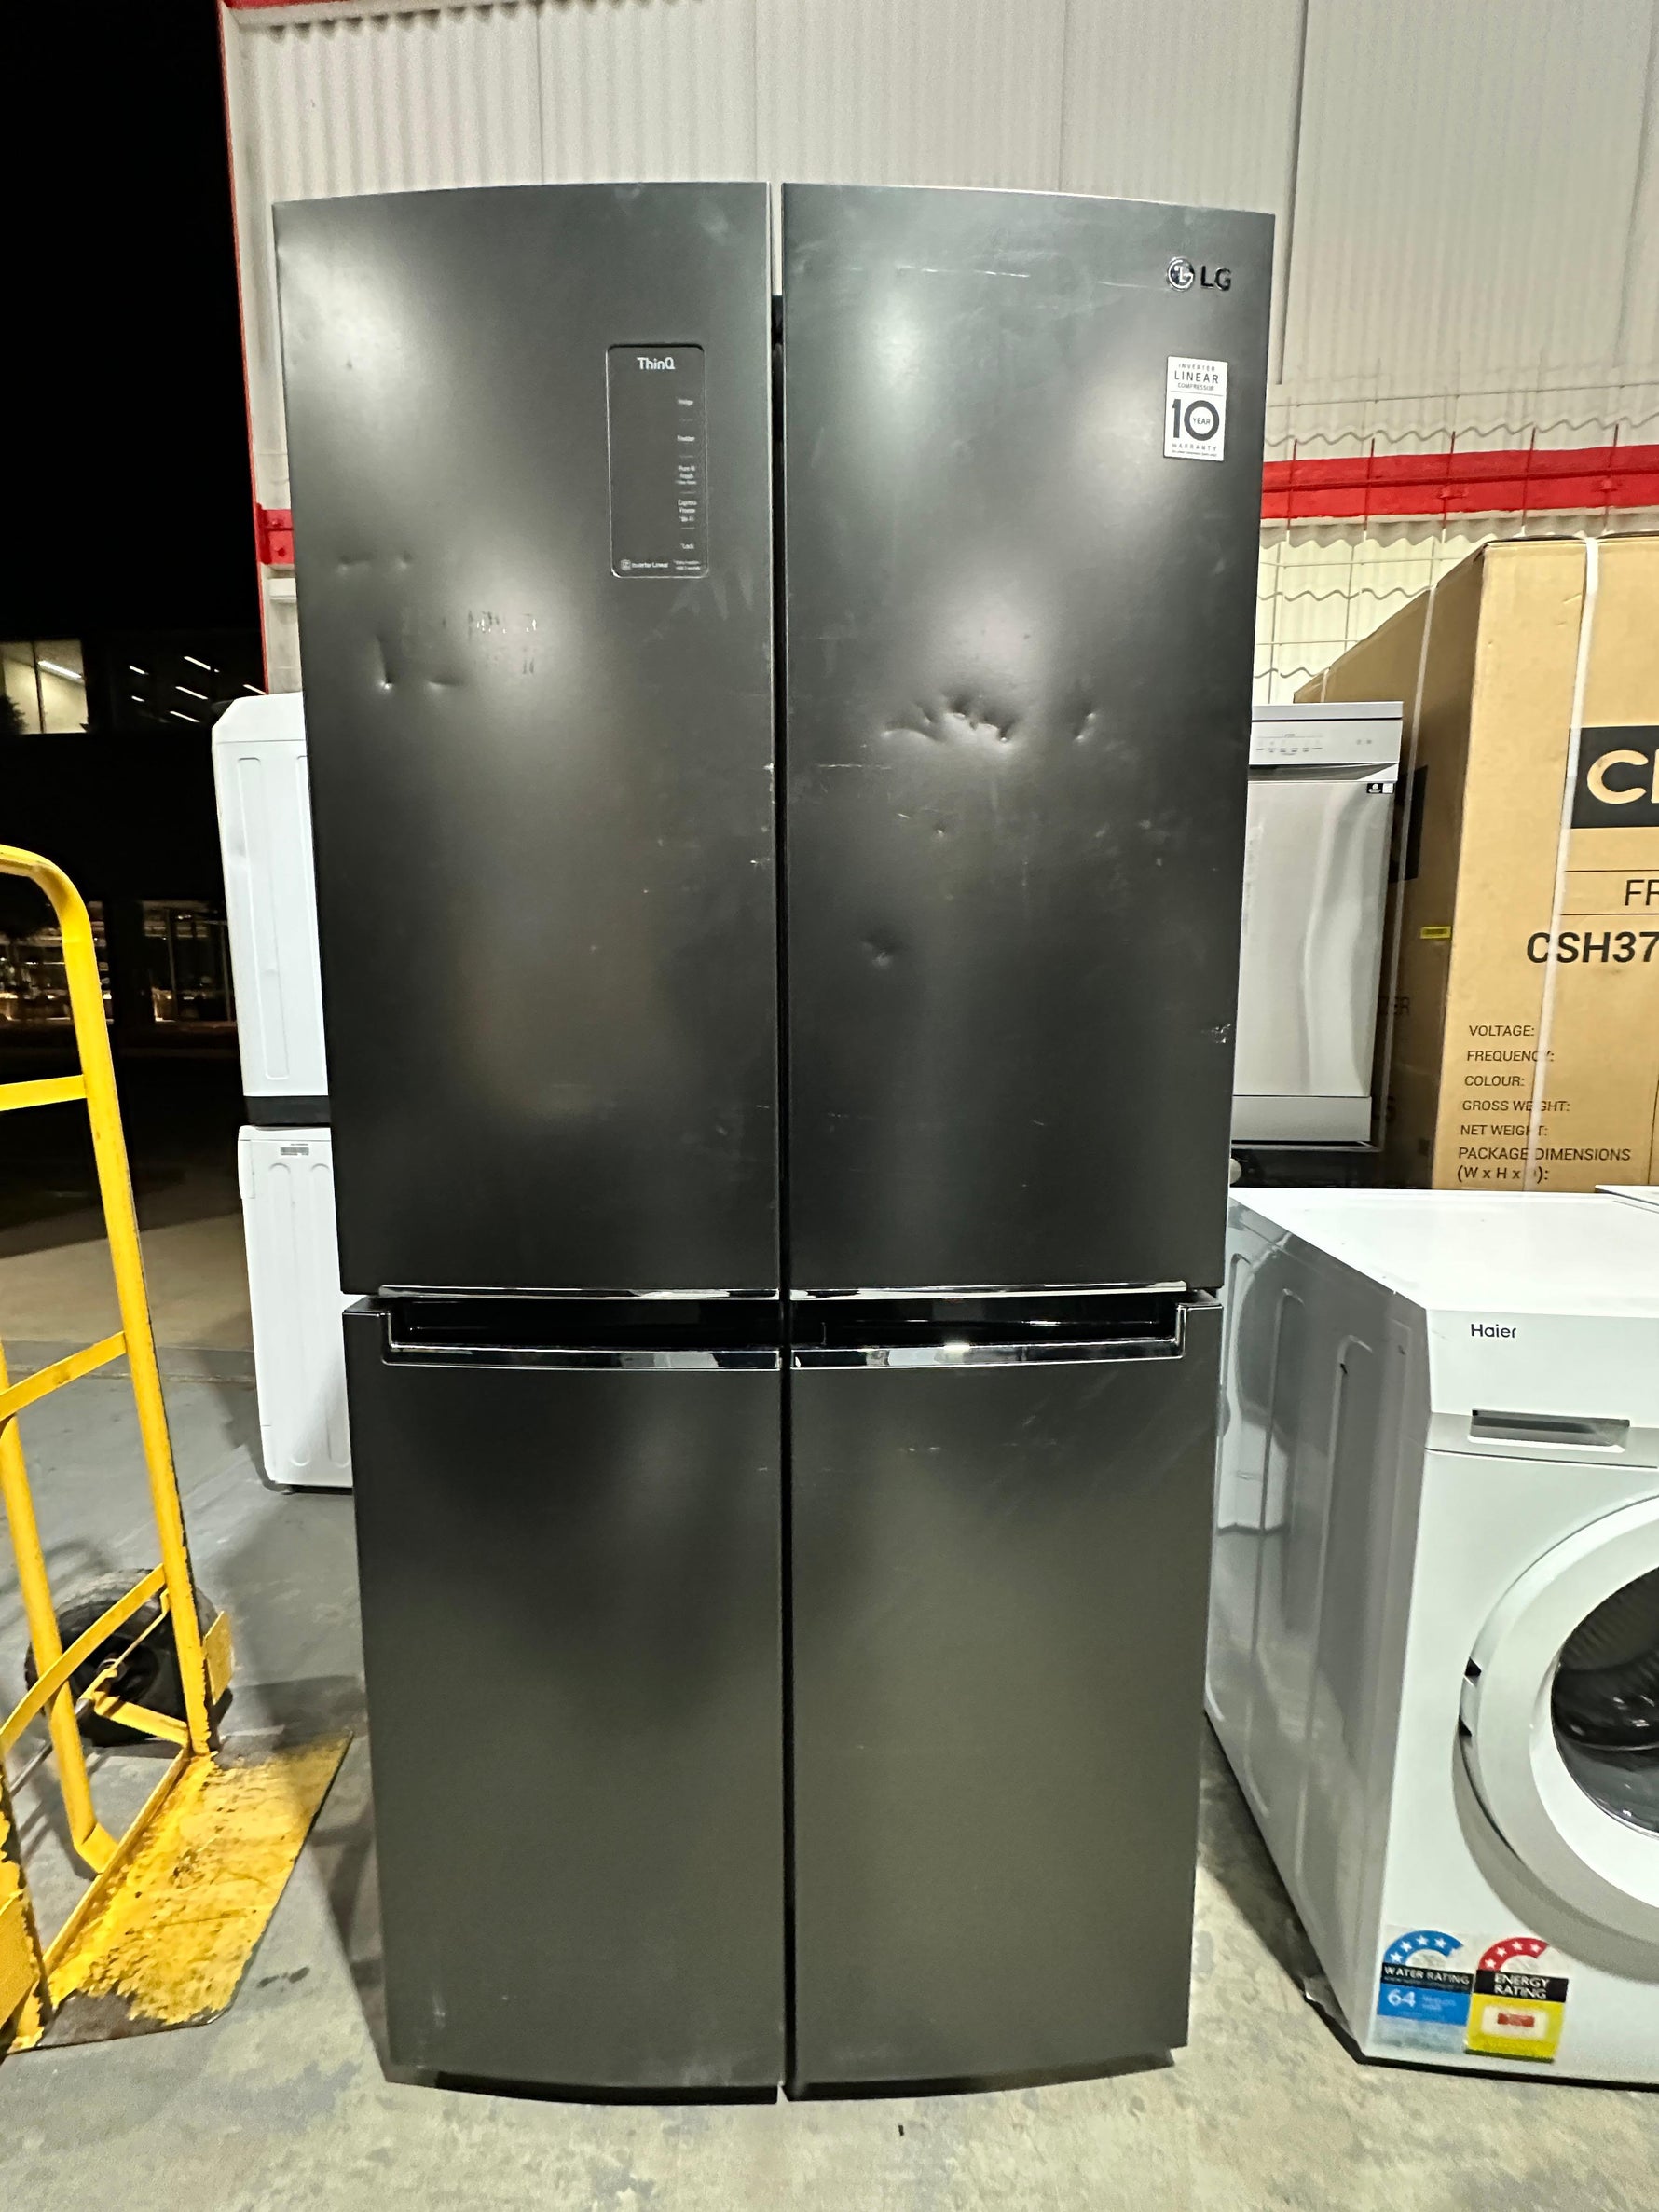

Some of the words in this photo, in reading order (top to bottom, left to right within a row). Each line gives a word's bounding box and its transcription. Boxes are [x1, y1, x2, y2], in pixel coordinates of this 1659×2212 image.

[1200, 266, 1231, 291] LG
[637, 356, 676, 370] ThinQ
[1178, 363, 1215, 372] INVERTER
[1174, 370, 1219, 384] LINEAR
[1177, 382, 1214, 392] COMPRESSOR
[1172, 398, 1220, 441] 10
[1192, 417, 1211, 425] YEAR
[1172, 443, 1217, 452] WARRANTY
[1587, 749, 1659, 804] C
[1469, 1025, 1535, 1037] VOLTAGE:
[1467, 1050, 1555, 1062] FREQUENC:
[1464, 1075, 1525, 1087] COLOUR:
[1462, 1100, 1509, 1111] GROSS
[1513, 1100, 1570, 1112] WEGHT:
[1460, 1124, 1487, 1136] NET
[1459, 1147, 1529, 1160] PACKAGE
[1534, 1147, 1631, 1161] DIMENSIONS
[1457, 1165, 1478, 1183] (W
[1482, 1169, 1491, 1179] x
[1496, 1167, 1508, 1179] H
[1512, 1169, 1521, 1179] x
[1471, 1323, 1516, 1339] Haier
[1384, 1965, 1424, 1979] WATER
[1427, 1970, 1470, 1985] RATING
[1494, 1972, 1550, 1988] ENERGY
[1387, 1988, 1416, 2007] 64
[1494, 1984, 1547, 1999] RATING
